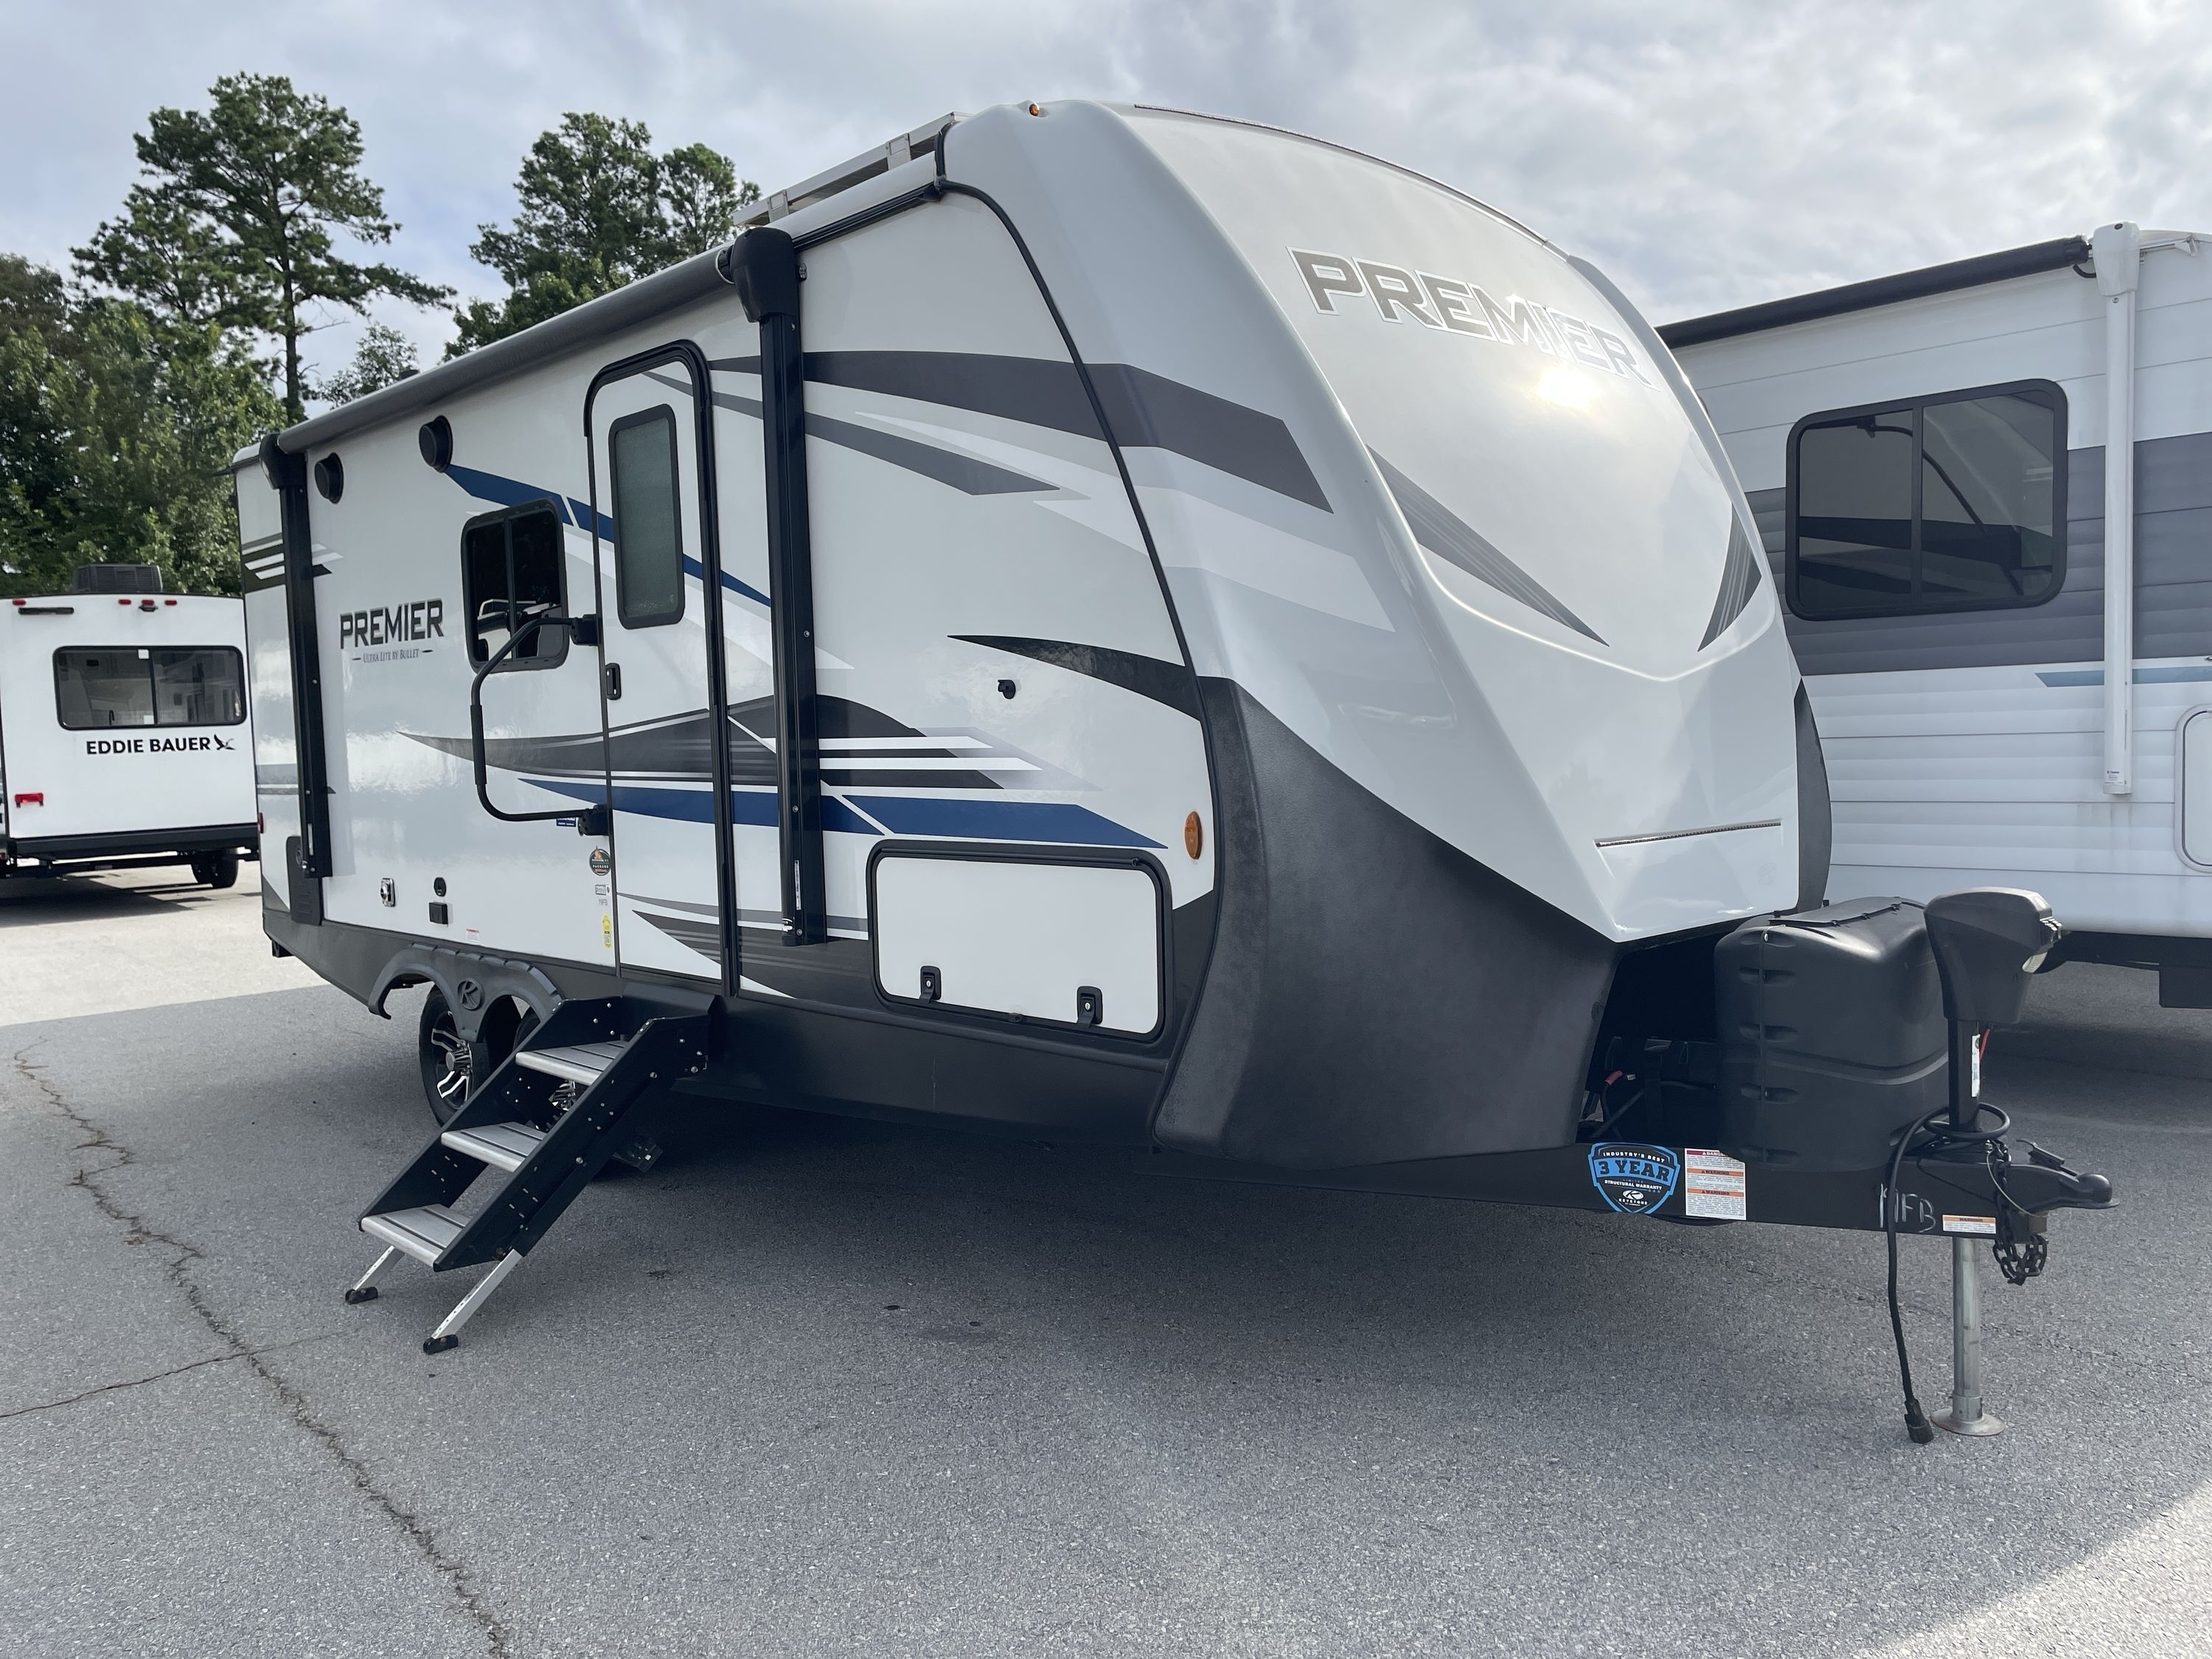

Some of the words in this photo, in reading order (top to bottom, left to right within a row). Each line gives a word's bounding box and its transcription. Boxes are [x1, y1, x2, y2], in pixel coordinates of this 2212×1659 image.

[1286, 246, 1662, 392] PREMIER
[339, 598, 444, 650] PREMIER
[363, 653, 379, 663] ULTRA
[380, 651, 391, 661] LITE
[400, 649, 420, 658] BULLET
[86, 740, 144, 754] EDDIE
[150, 737, 210, 752] BAUER
[1599, 1161, 1610, 1175] 3
[1615, 1160, 1671, 1182] YEAR
